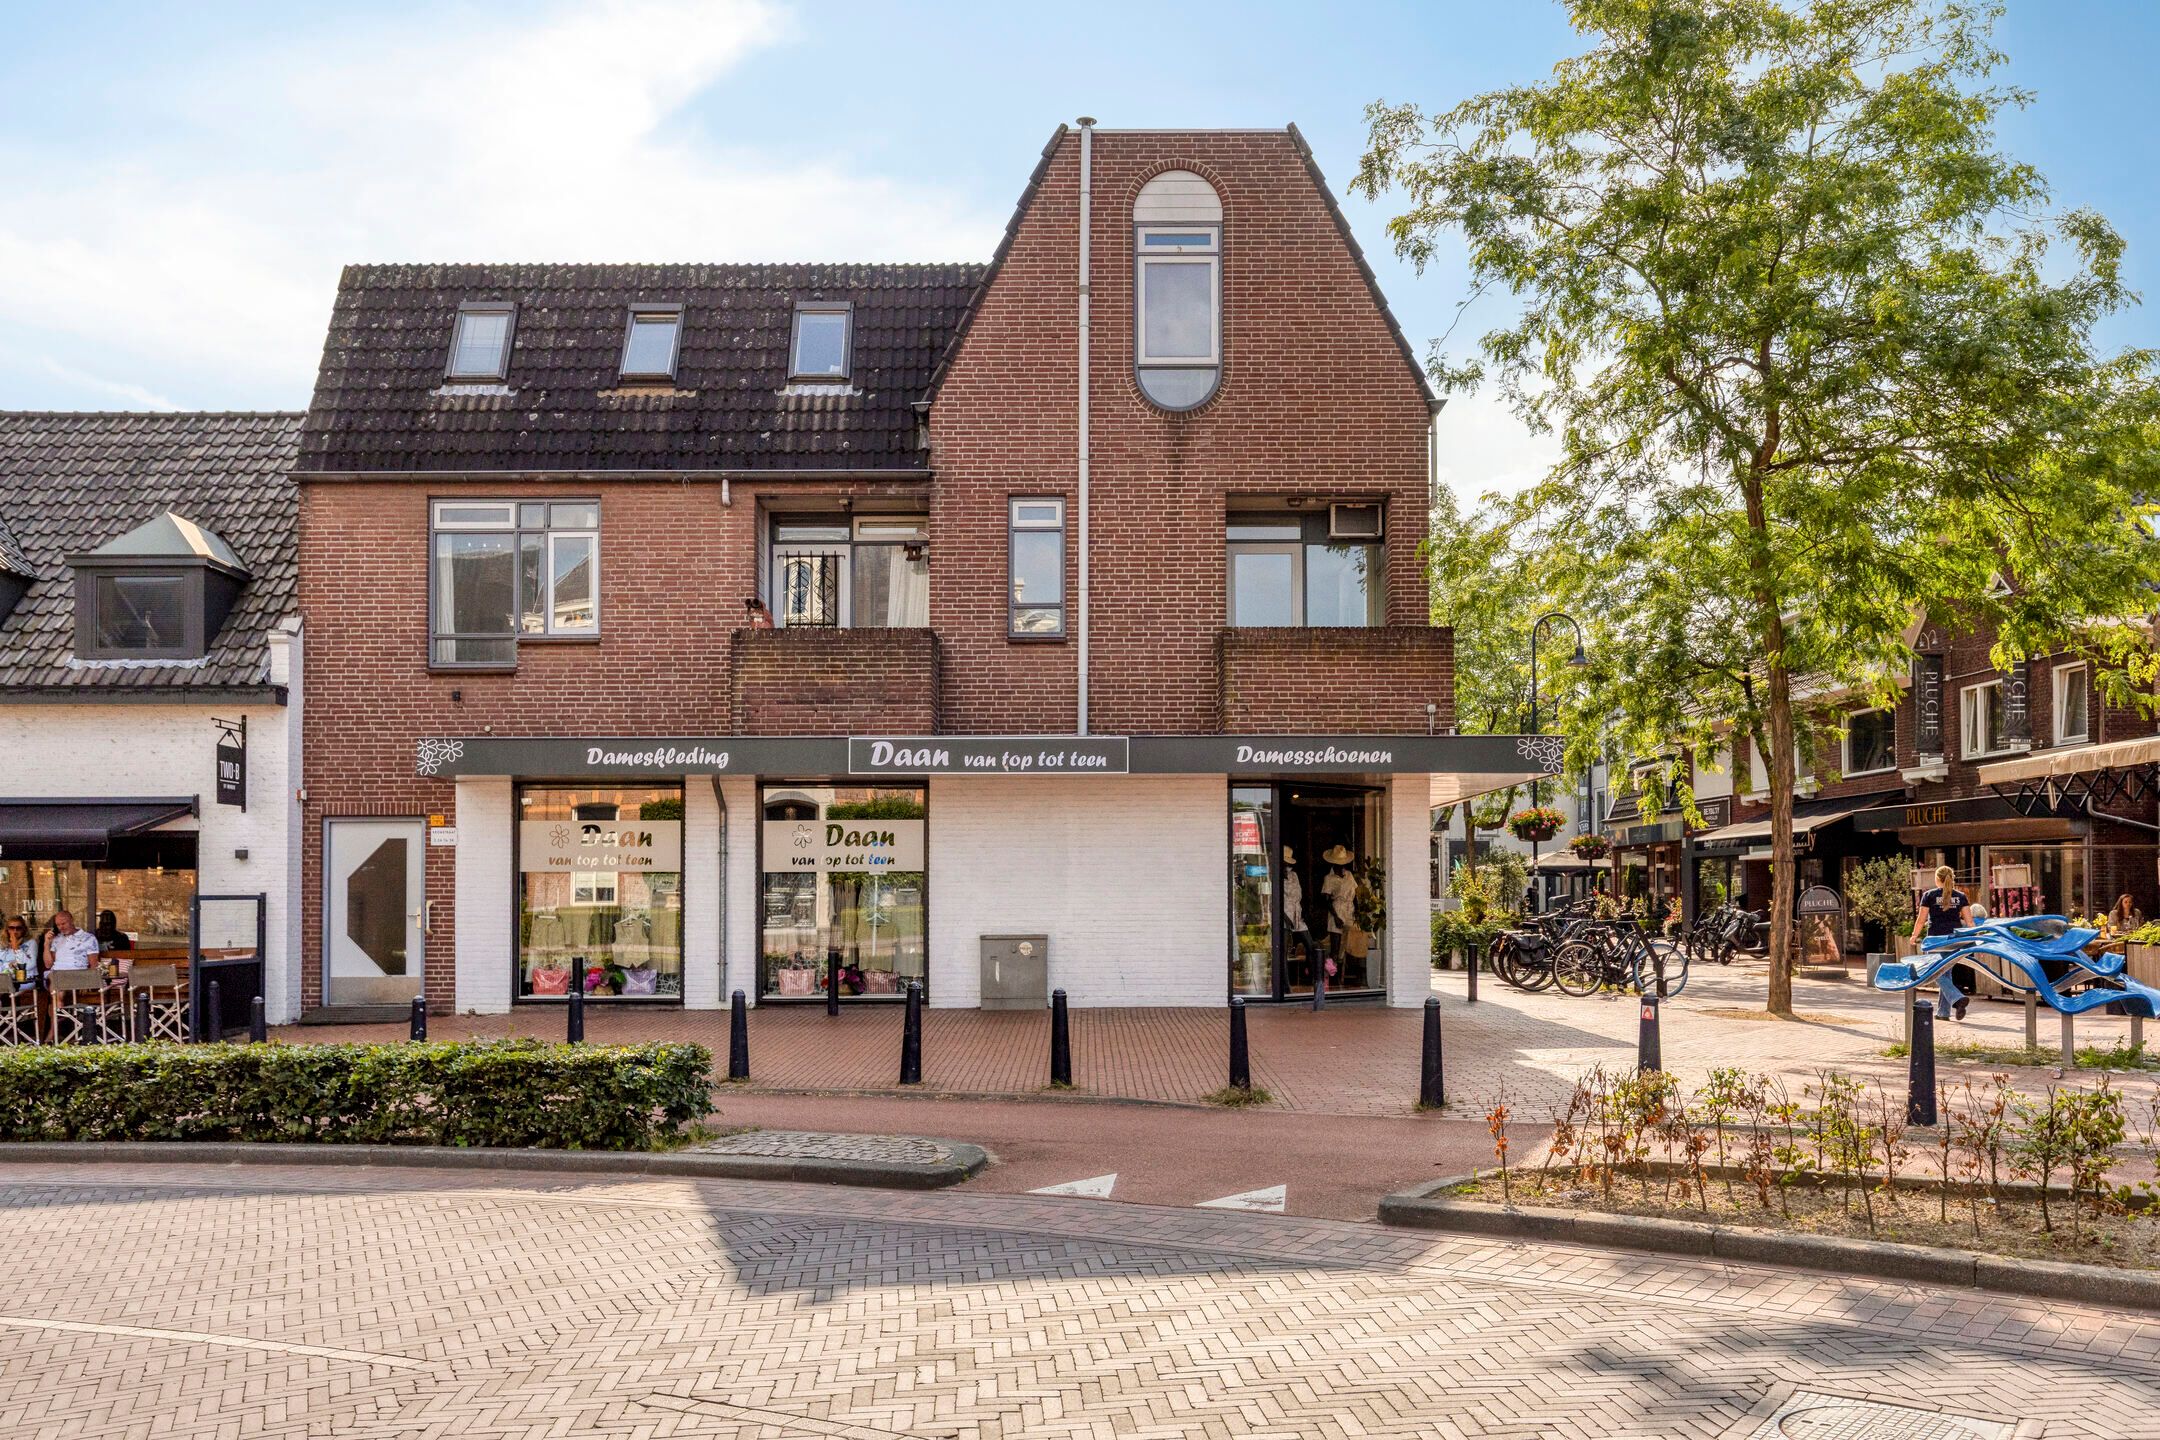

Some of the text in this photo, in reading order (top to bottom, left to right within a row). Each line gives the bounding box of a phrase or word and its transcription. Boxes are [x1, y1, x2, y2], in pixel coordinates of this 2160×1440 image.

[2011, 659, 2026, 720] LUCHE
[1925, 671, 1939, 736] PLUCHE
[587, 747, 729, 769] Dameskleding
[870, 741, 1107, 770] Daan van top tot teen
[1237, 746, 1391, 764] Damesschoenen
[1906, 805, 1949, 825] PLUCHE
[581, 824, 652, 847] Daan
[824, 824, 895, 847] Daan
[549, 854, 653, 868] van top tot teen
[792, 856, 815, 866] van
[845, 854, 865, 865] tot
[869, 854, 895, 865] teen
[1804, 899, 1834, 907] PLUCHE
